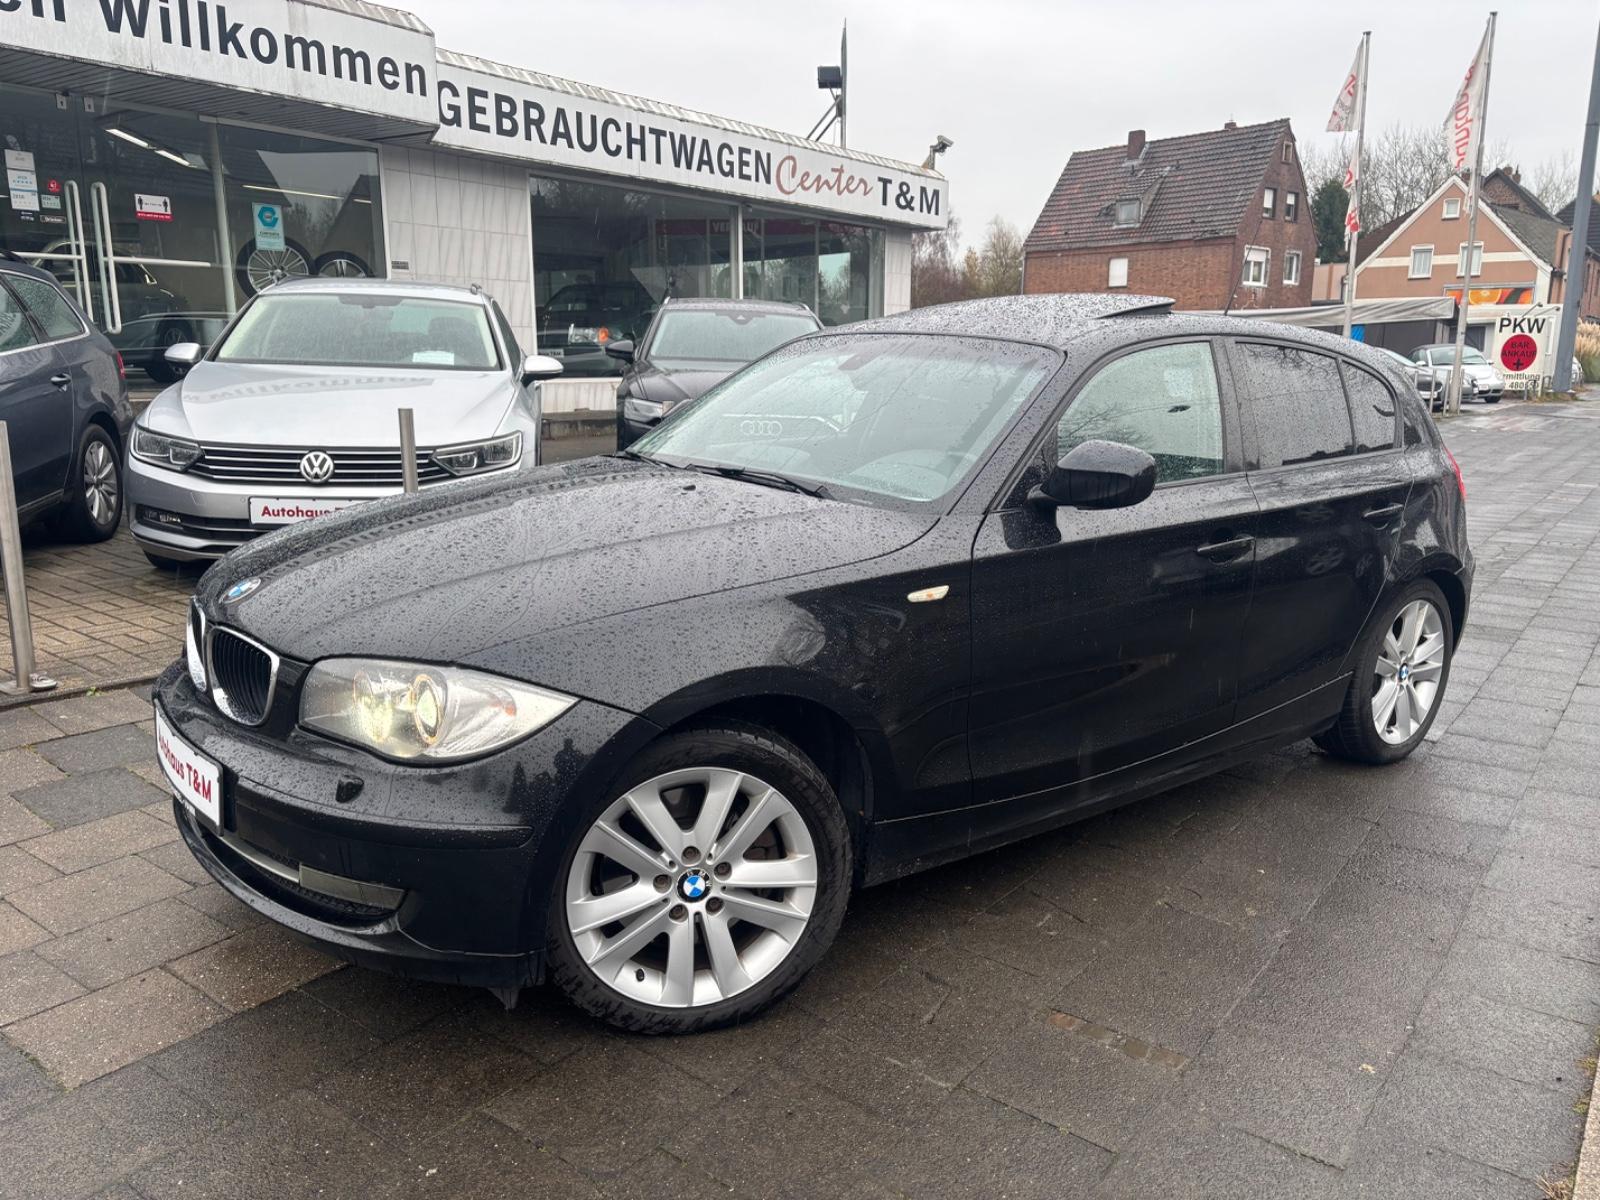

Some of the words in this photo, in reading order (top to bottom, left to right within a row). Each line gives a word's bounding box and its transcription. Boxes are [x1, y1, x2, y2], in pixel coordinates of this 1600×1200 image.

[98, 0, 427, 97] Willkommen
[438, 80, 771, 185] GEBRAUCHTWAGEN
[776, 155, 873, 196] Center
[877, 176, 940, 216] T&M
[1499, 317, 1546, 334] PKW
[1501, 350, 1537, 358] ANKAUF
[1503, 373, 1540, 381] rmittlung
[186, 762, 211, 803] T&M
